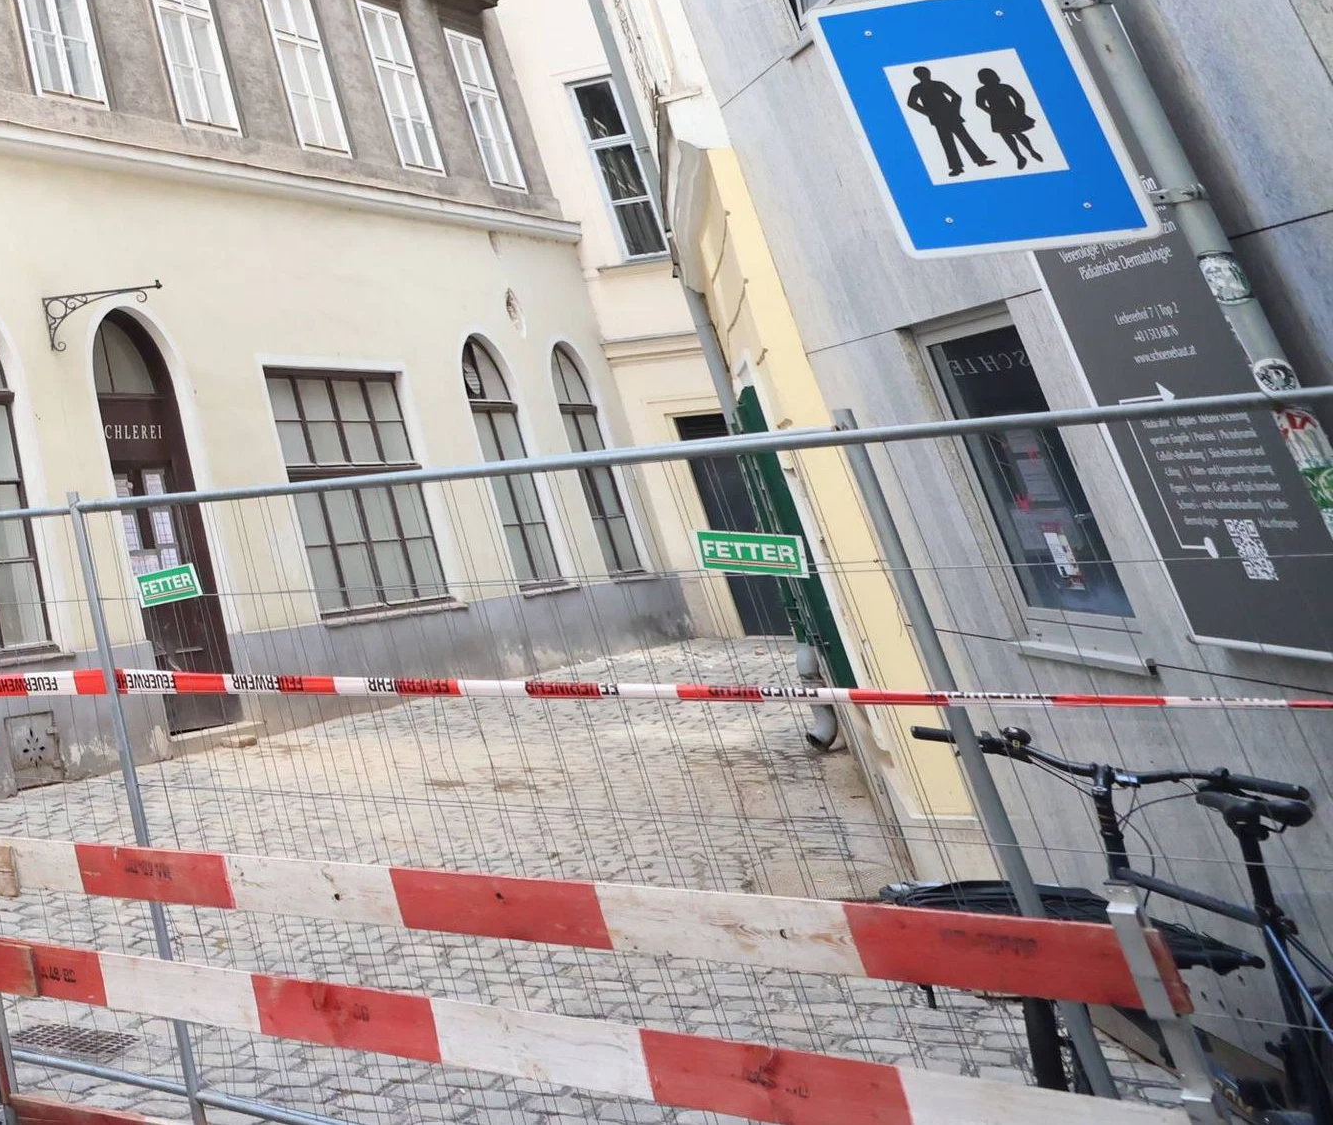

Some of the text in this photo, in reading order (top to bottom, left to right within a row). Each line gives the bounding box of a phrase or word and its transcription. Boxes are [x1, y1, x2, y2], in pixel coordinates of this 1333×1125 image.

[1120, 243, 1174, 269] Dermatologie
[701, 540, 796, 562] FETTER
[140, 572, 194, 596] FETTER
[231, 675, 304, 691] FEUERWEHR
